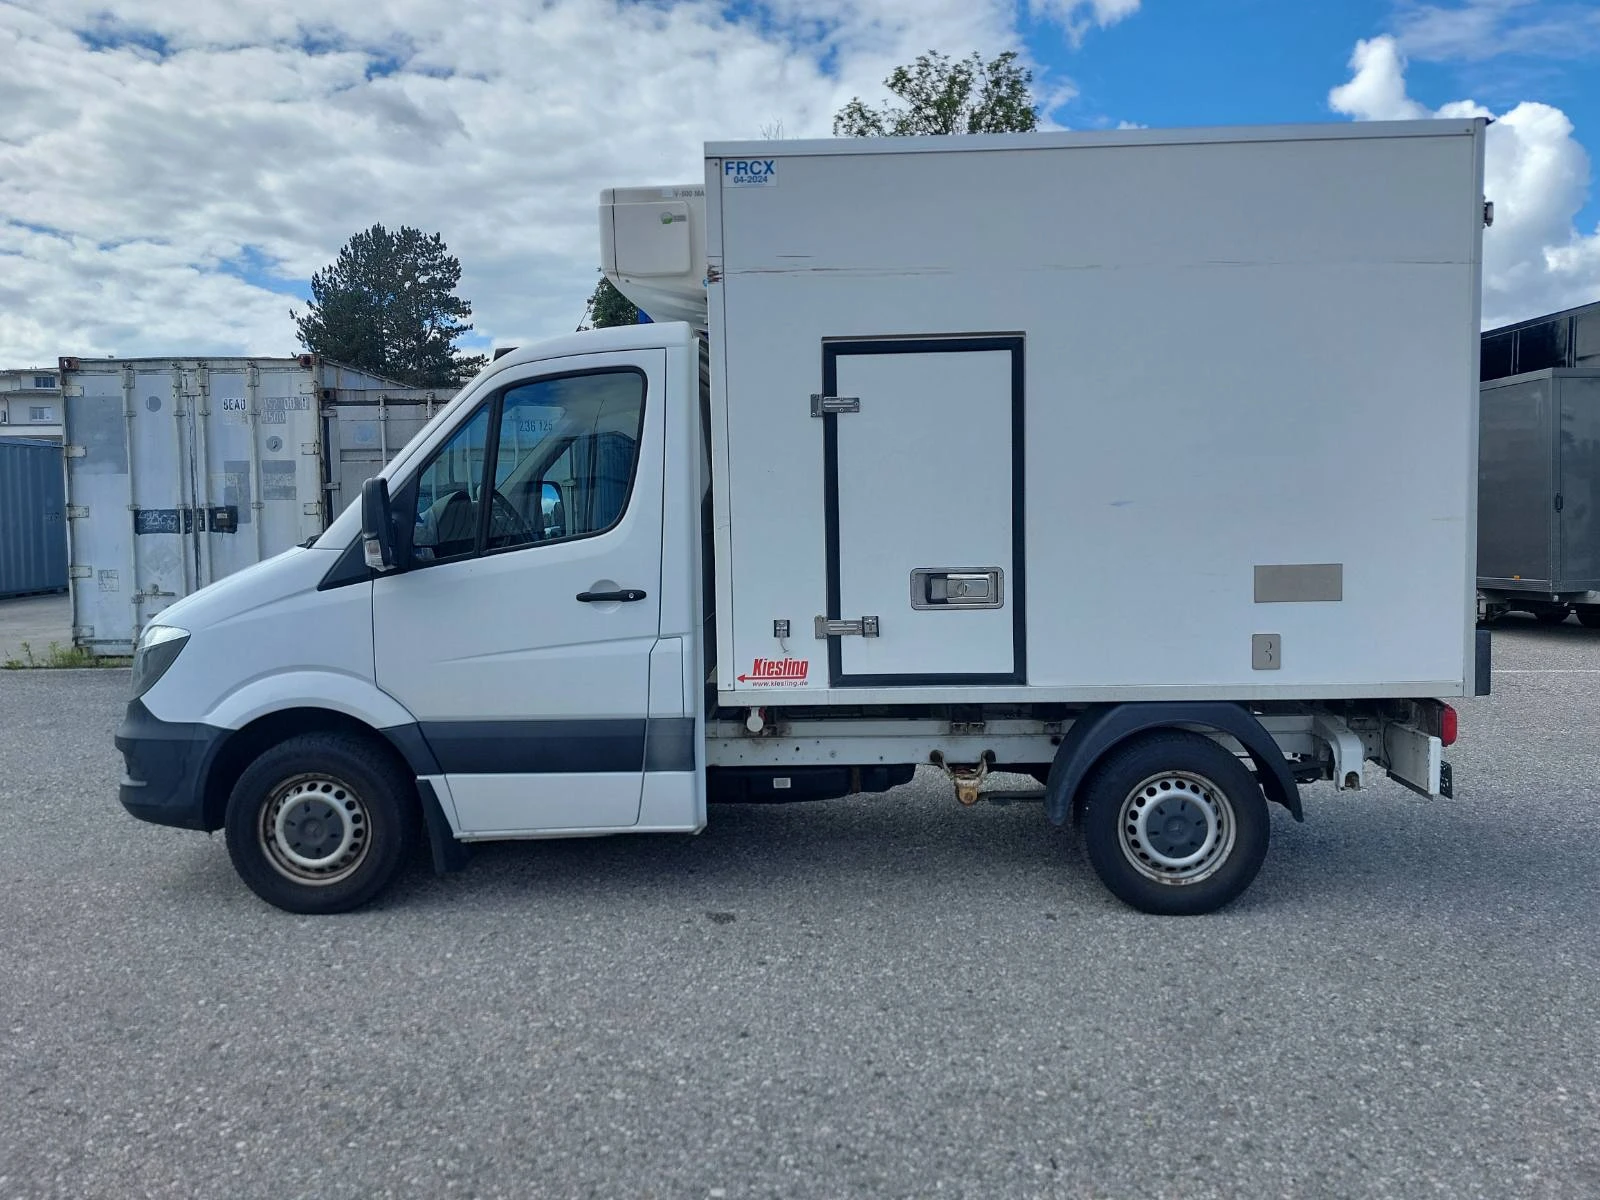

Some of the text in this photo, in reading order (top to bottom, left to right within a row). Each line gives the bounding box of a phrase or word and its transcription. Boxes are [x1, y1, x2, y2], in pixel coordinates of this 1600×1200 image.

[725, 160, 775, 175] FRCX
[733, 175, 768, 184] 04-2024
[223, 398, 246, 410] BEAU
[519, 420, 536, 432] 236
[752, 658, 809, 676] Kiesling
[752, 680, 809, 688] www.kiesling.de
